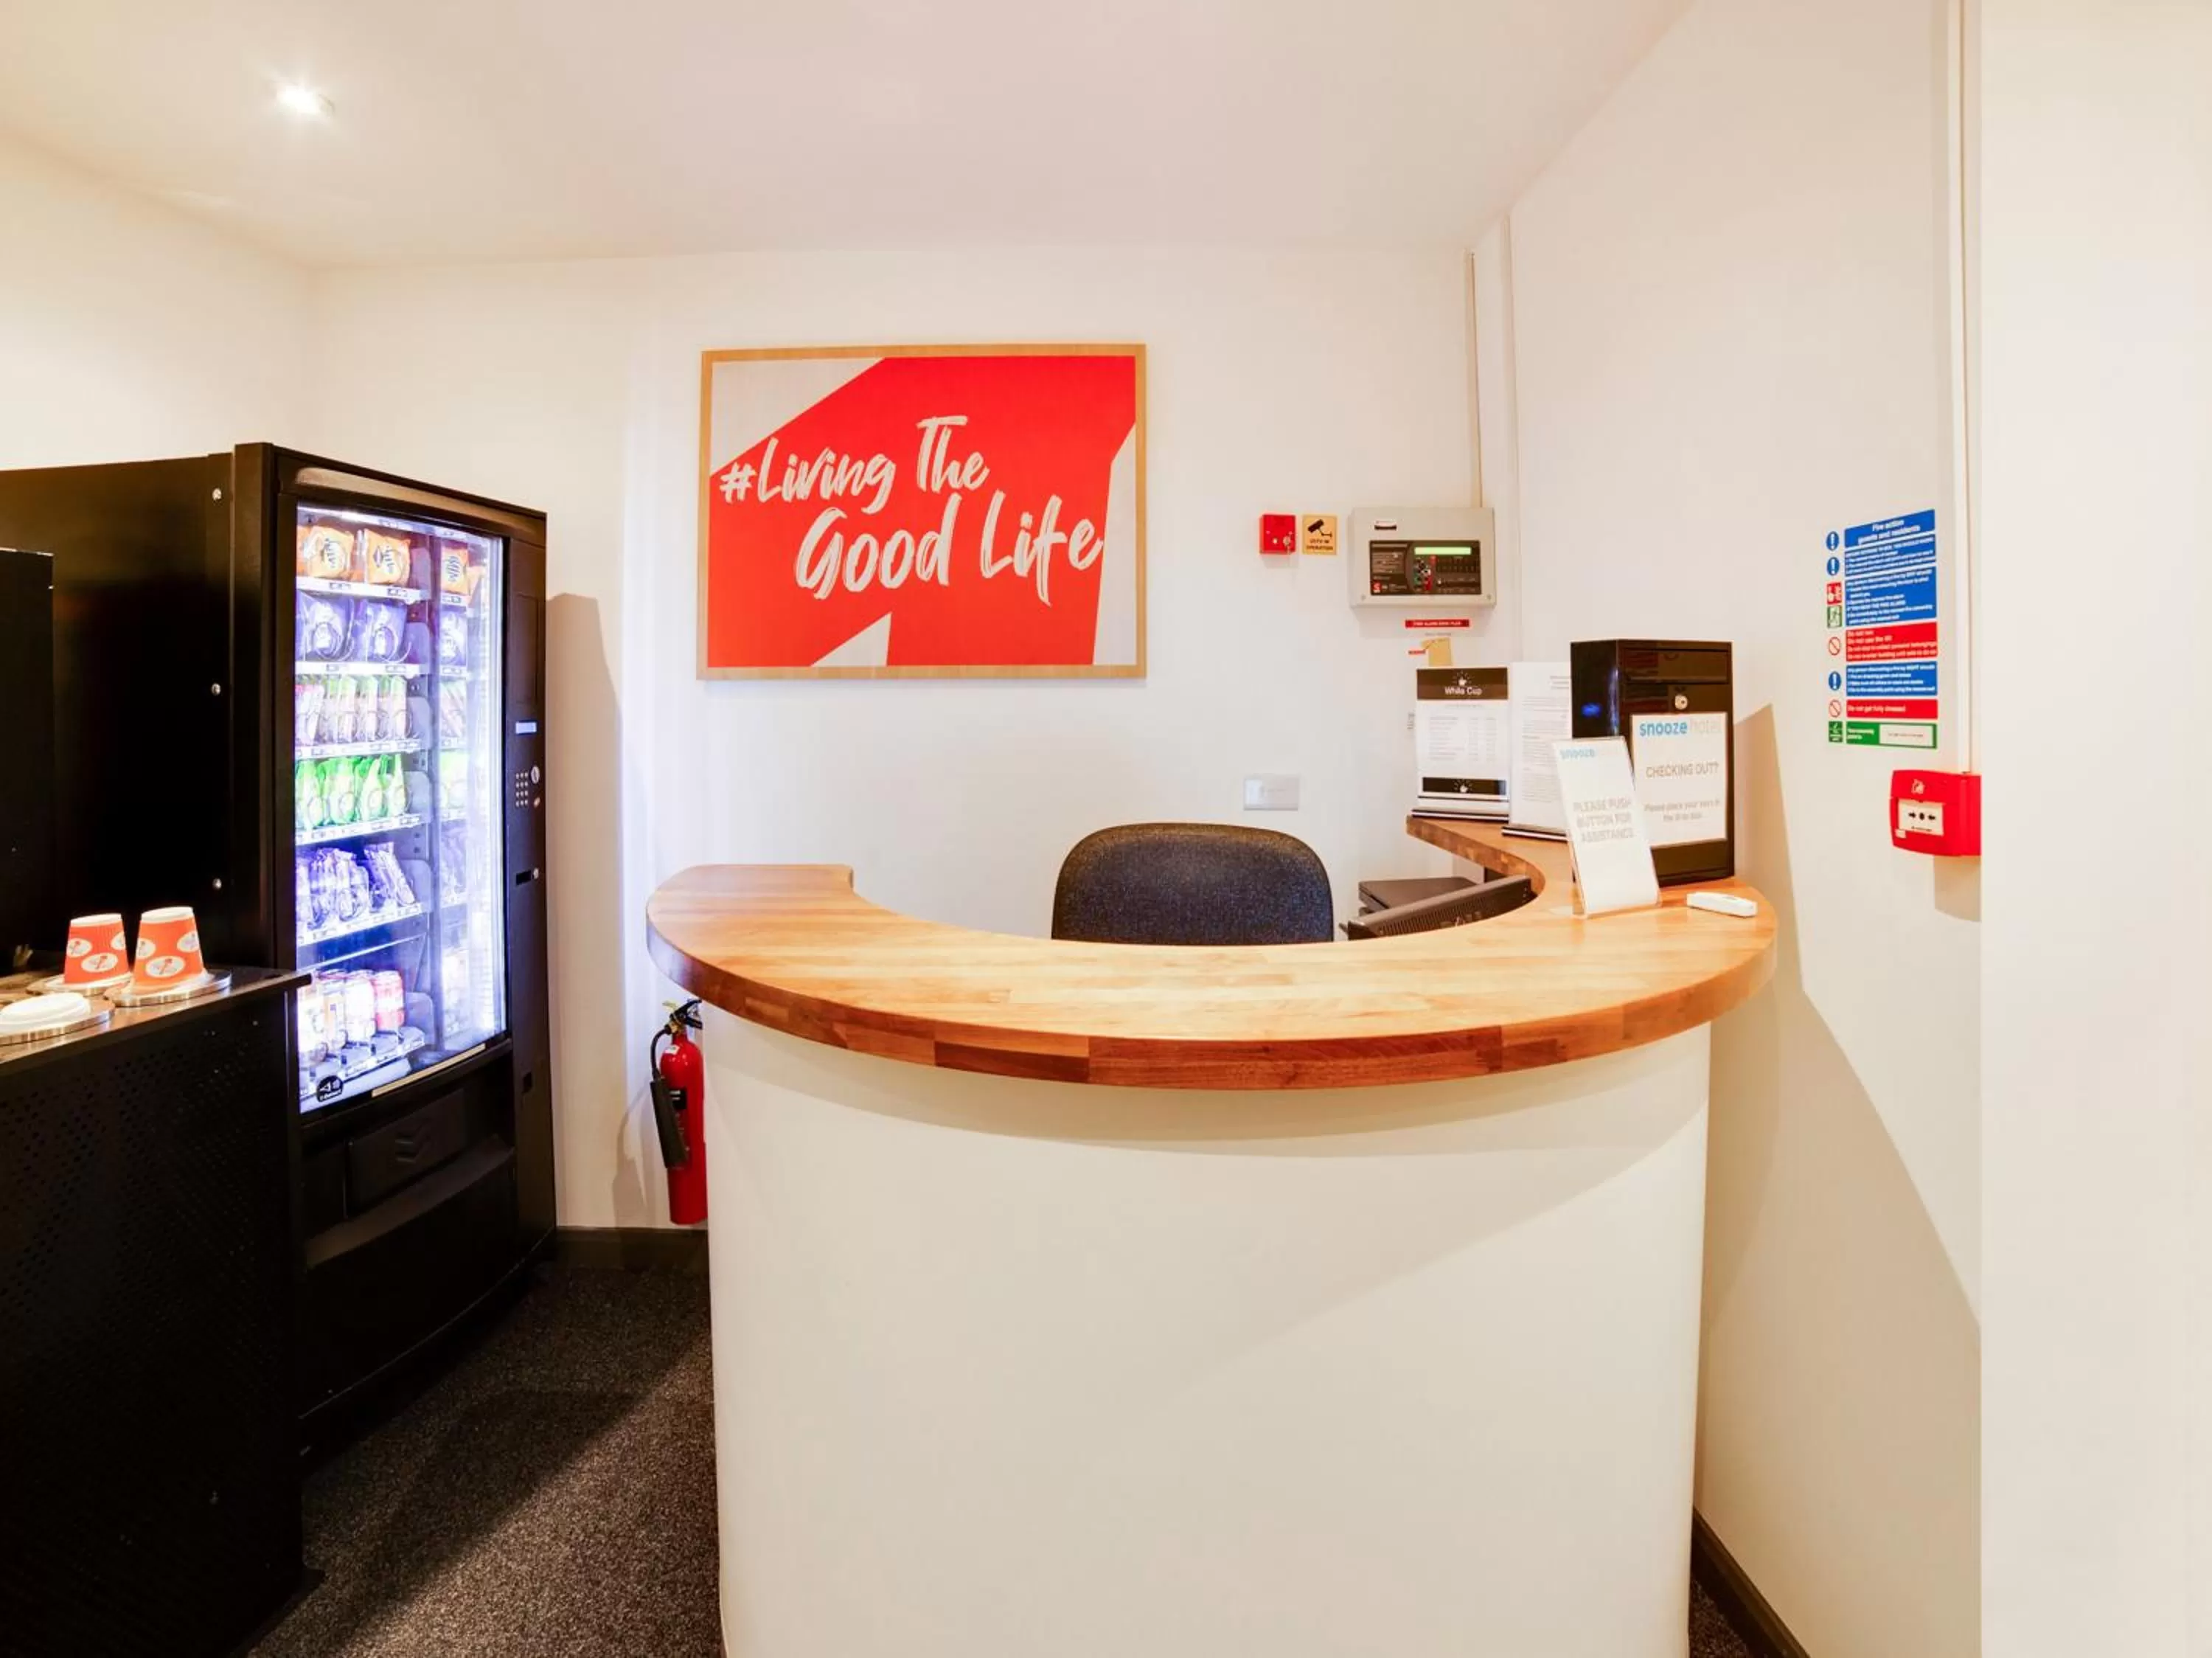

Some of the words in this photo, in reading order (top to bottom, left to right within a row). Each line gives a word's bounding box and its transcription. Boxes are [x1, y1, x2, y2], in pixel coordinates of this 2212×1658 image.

[719, 437, 896, 513] #Living
[916, 415, 990, 493] The
[795, 493, 962, 600] Good
[979, 489, 1104, 607] Life
[1639, 721, 1688, 737] snooze
[1645, 763, 1694, 779] CHECKING
[1695, 761, 1719, 775] OUT?
